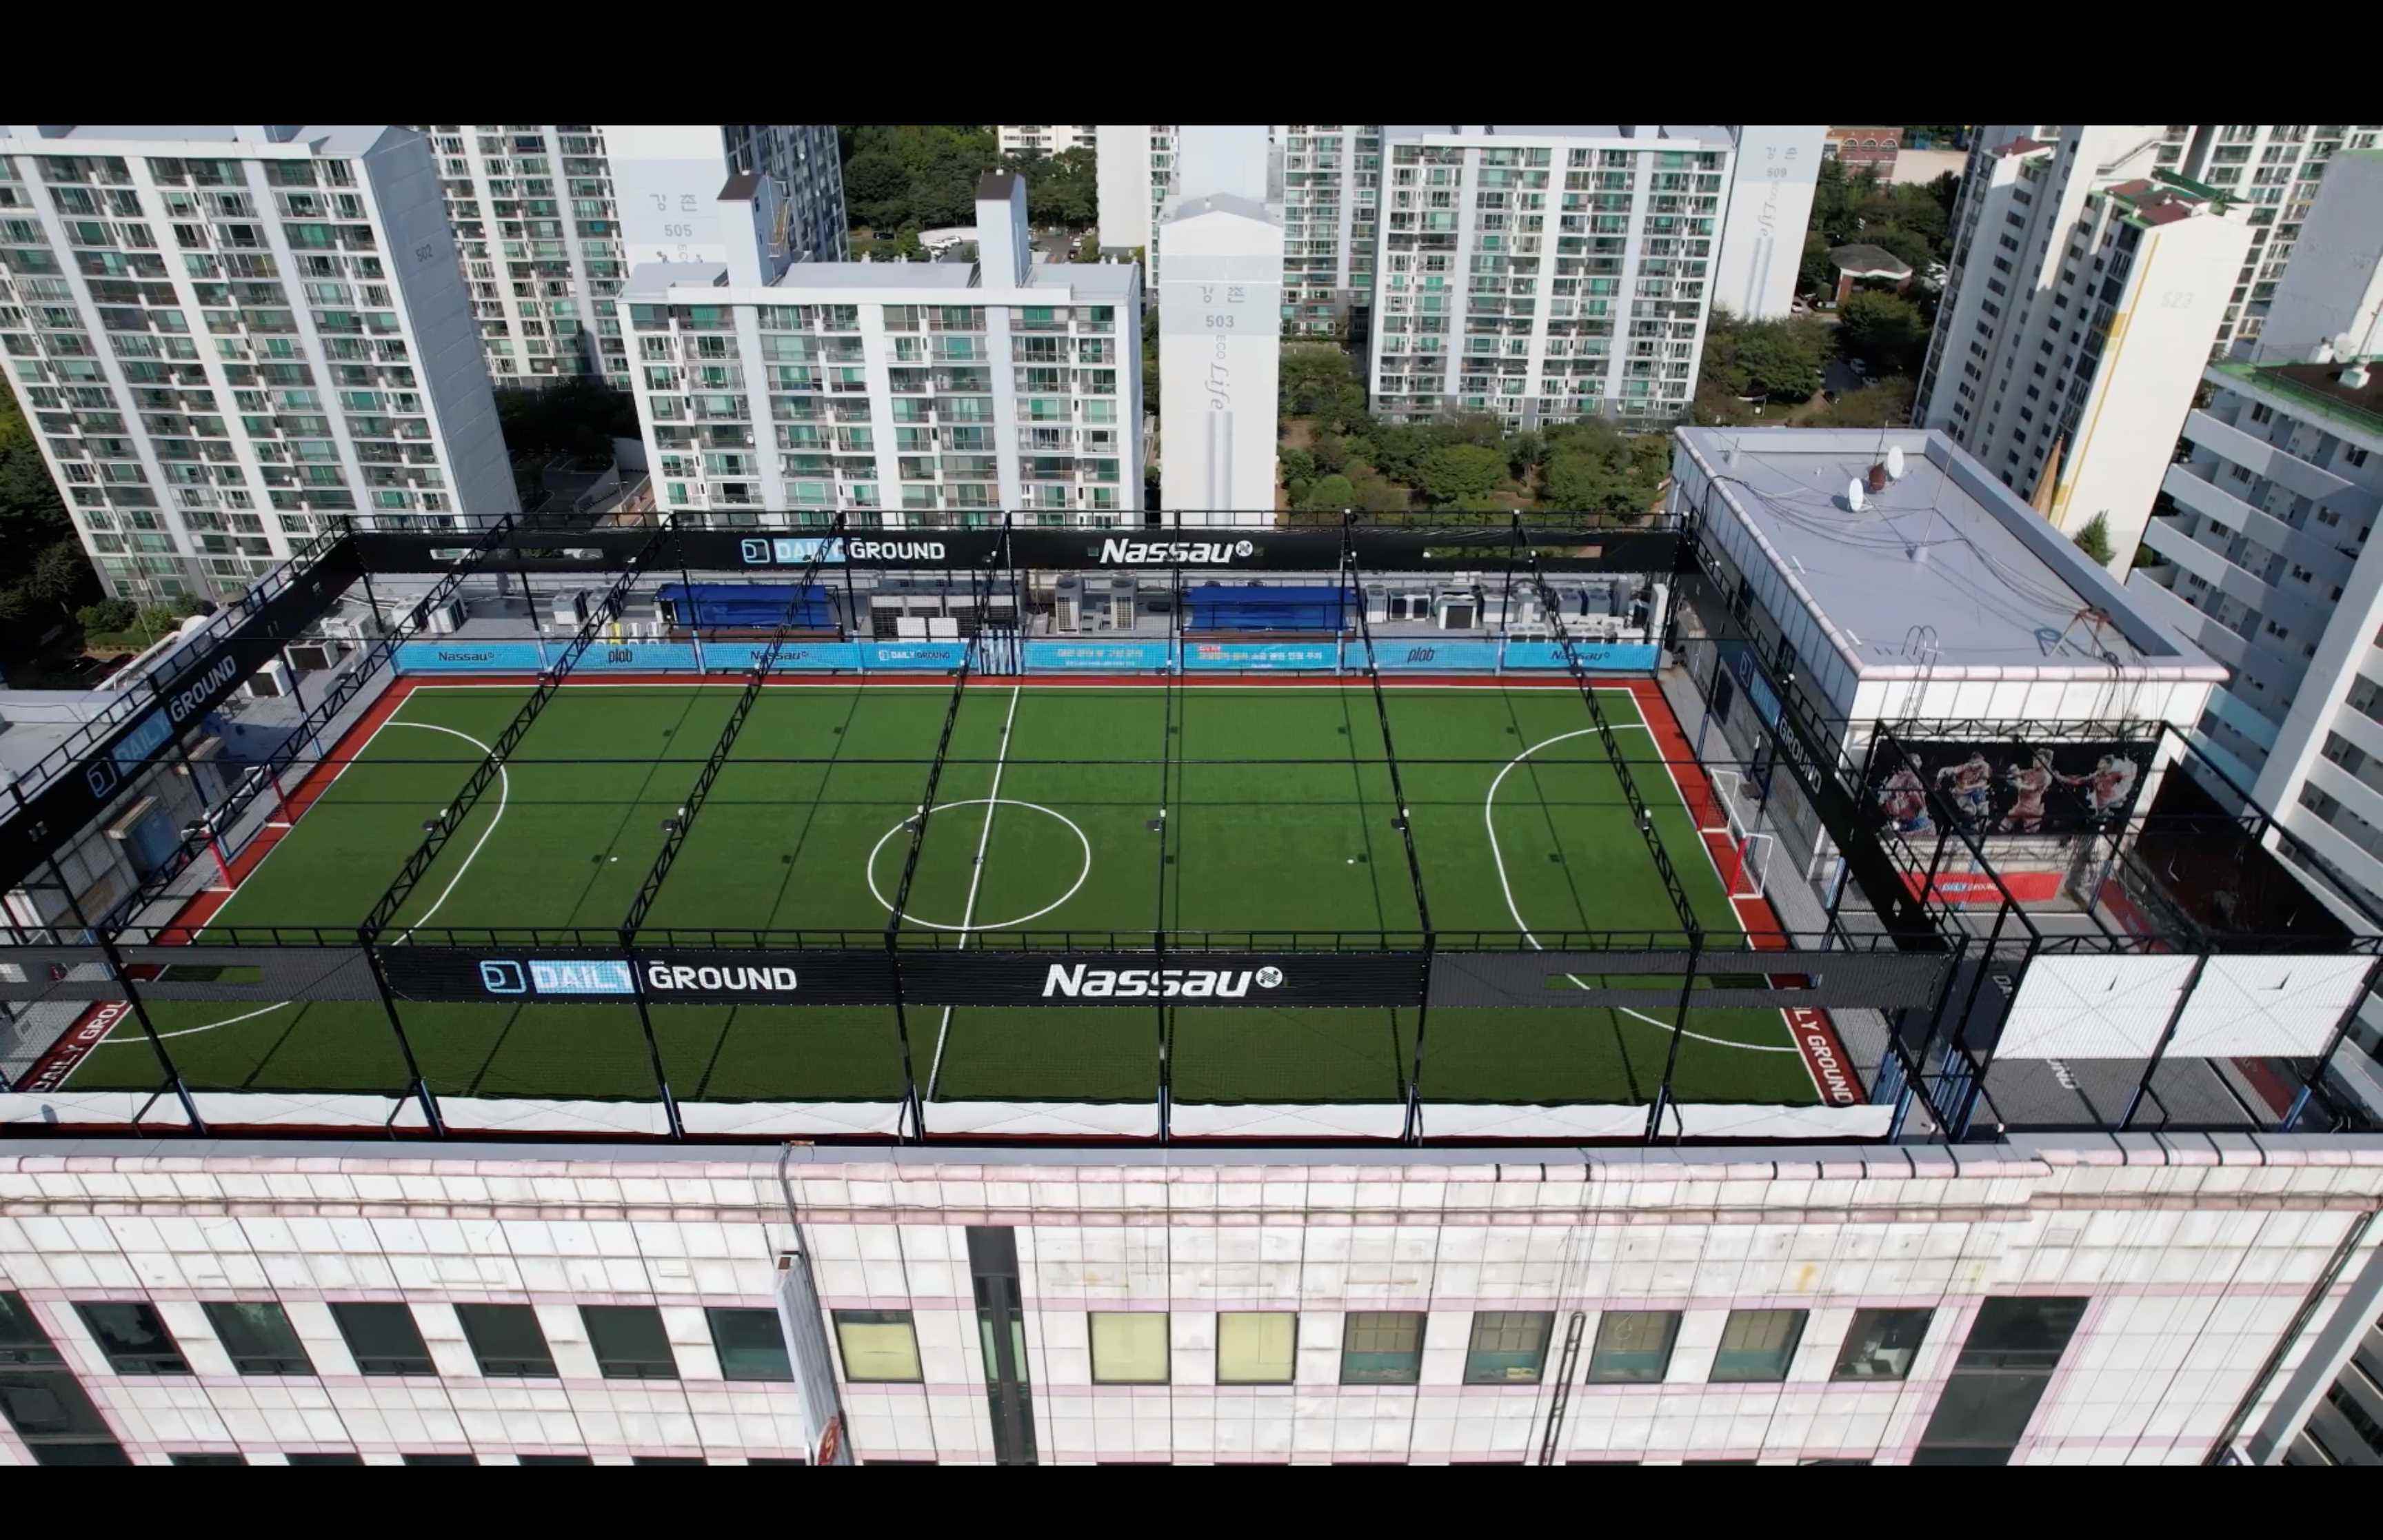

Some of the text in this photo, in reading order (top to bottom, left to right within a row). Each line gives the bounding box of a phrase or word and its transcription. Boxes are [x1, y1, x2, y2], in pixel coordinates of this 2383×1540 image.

[664, 224, 692, 237] 505
[415, 243, 433, 263] 502
[1206, 315, 1234, 328] 503
[1216, 334, 1227, 360] ECO
[1205, 362, 1231, 410] Life
[850, 538, 945, 560] GROUND
[1099, 538, 1234, 563] Nassau
[438, 651, 487, 661] Nassau
[170, 654, 237, 722] GROUND
[1779, 714, 1822, 793] GROUND
[532, 961, 796, 991] DAILY GROUND
[1042, 964, 1253, 997] Nassau
[1807, 1035, 1854, 1103] GROUND
